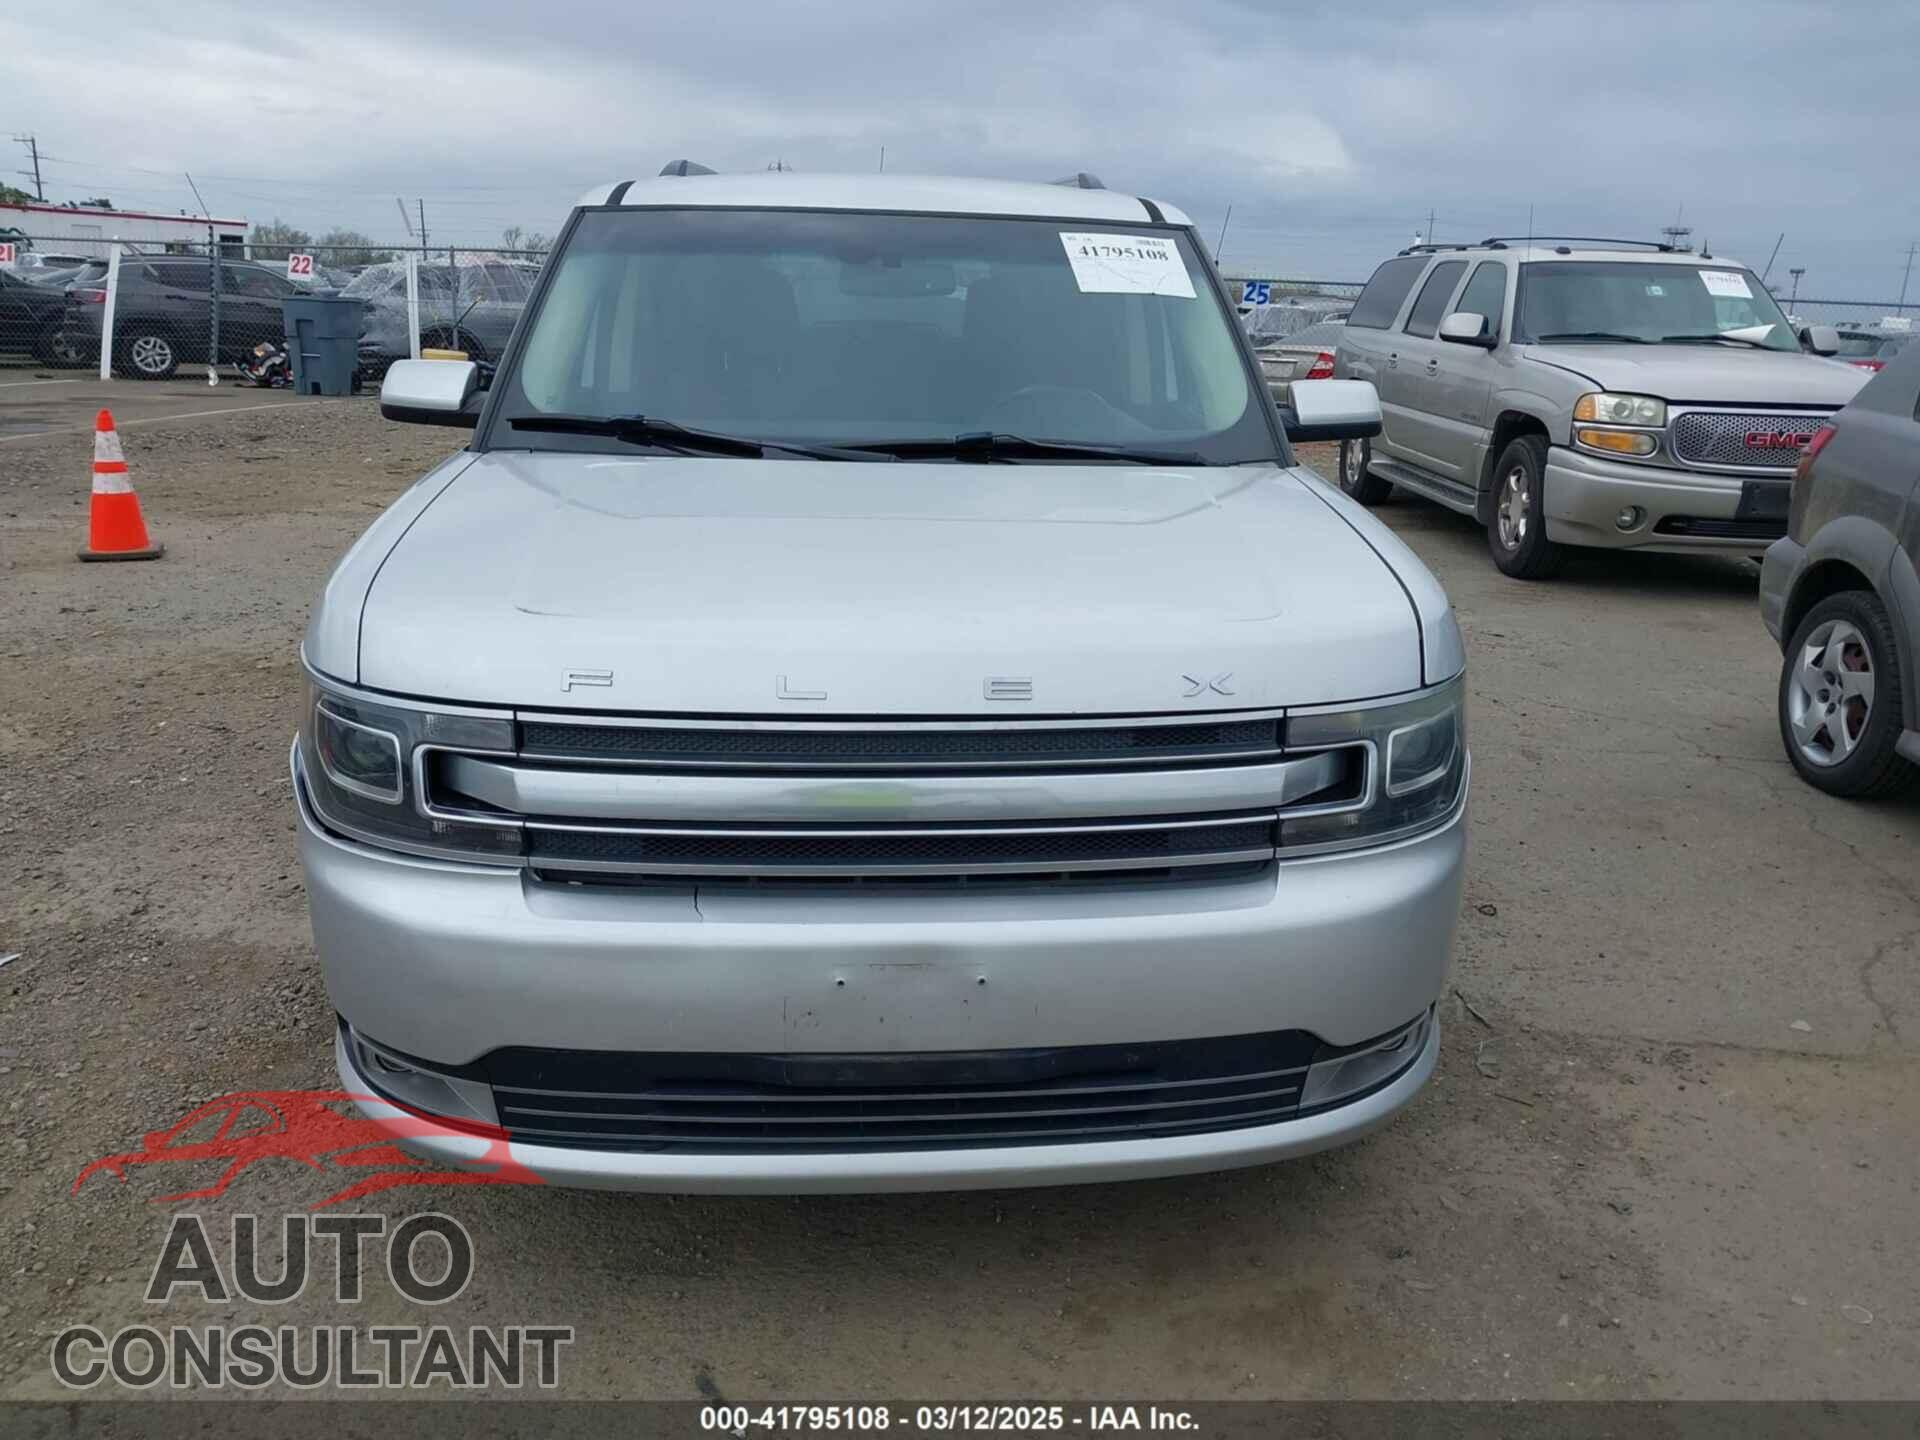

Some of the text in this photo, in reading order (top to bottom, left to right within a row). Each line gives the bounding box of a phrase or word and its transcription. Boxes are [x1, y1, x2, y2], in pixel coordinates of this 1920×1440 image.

[1078, 245, 1169, 261] 41795108
[290, 256, 311, 275] 22
[1243, 281, 1270, 304] 25
[1745, 431, 1815, 448] GMC
